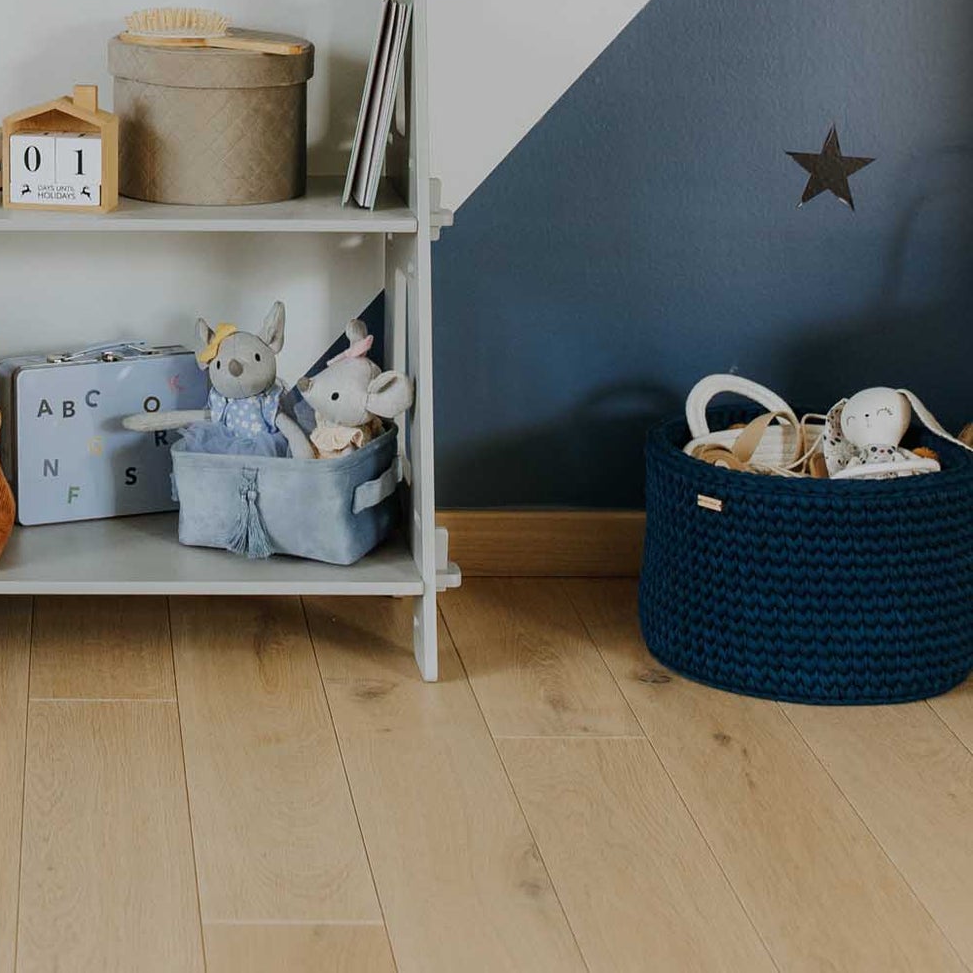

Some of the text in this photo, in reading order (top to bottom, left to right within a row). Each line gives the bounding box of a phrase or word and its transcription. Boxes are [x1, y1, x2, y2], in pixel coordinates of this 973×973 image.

[38, 192, 76, 200] HOLIDAYS
[43, 458, 59, 477] N
[124, 466, 138, 485] S
[67, 486, 81, 505] F
